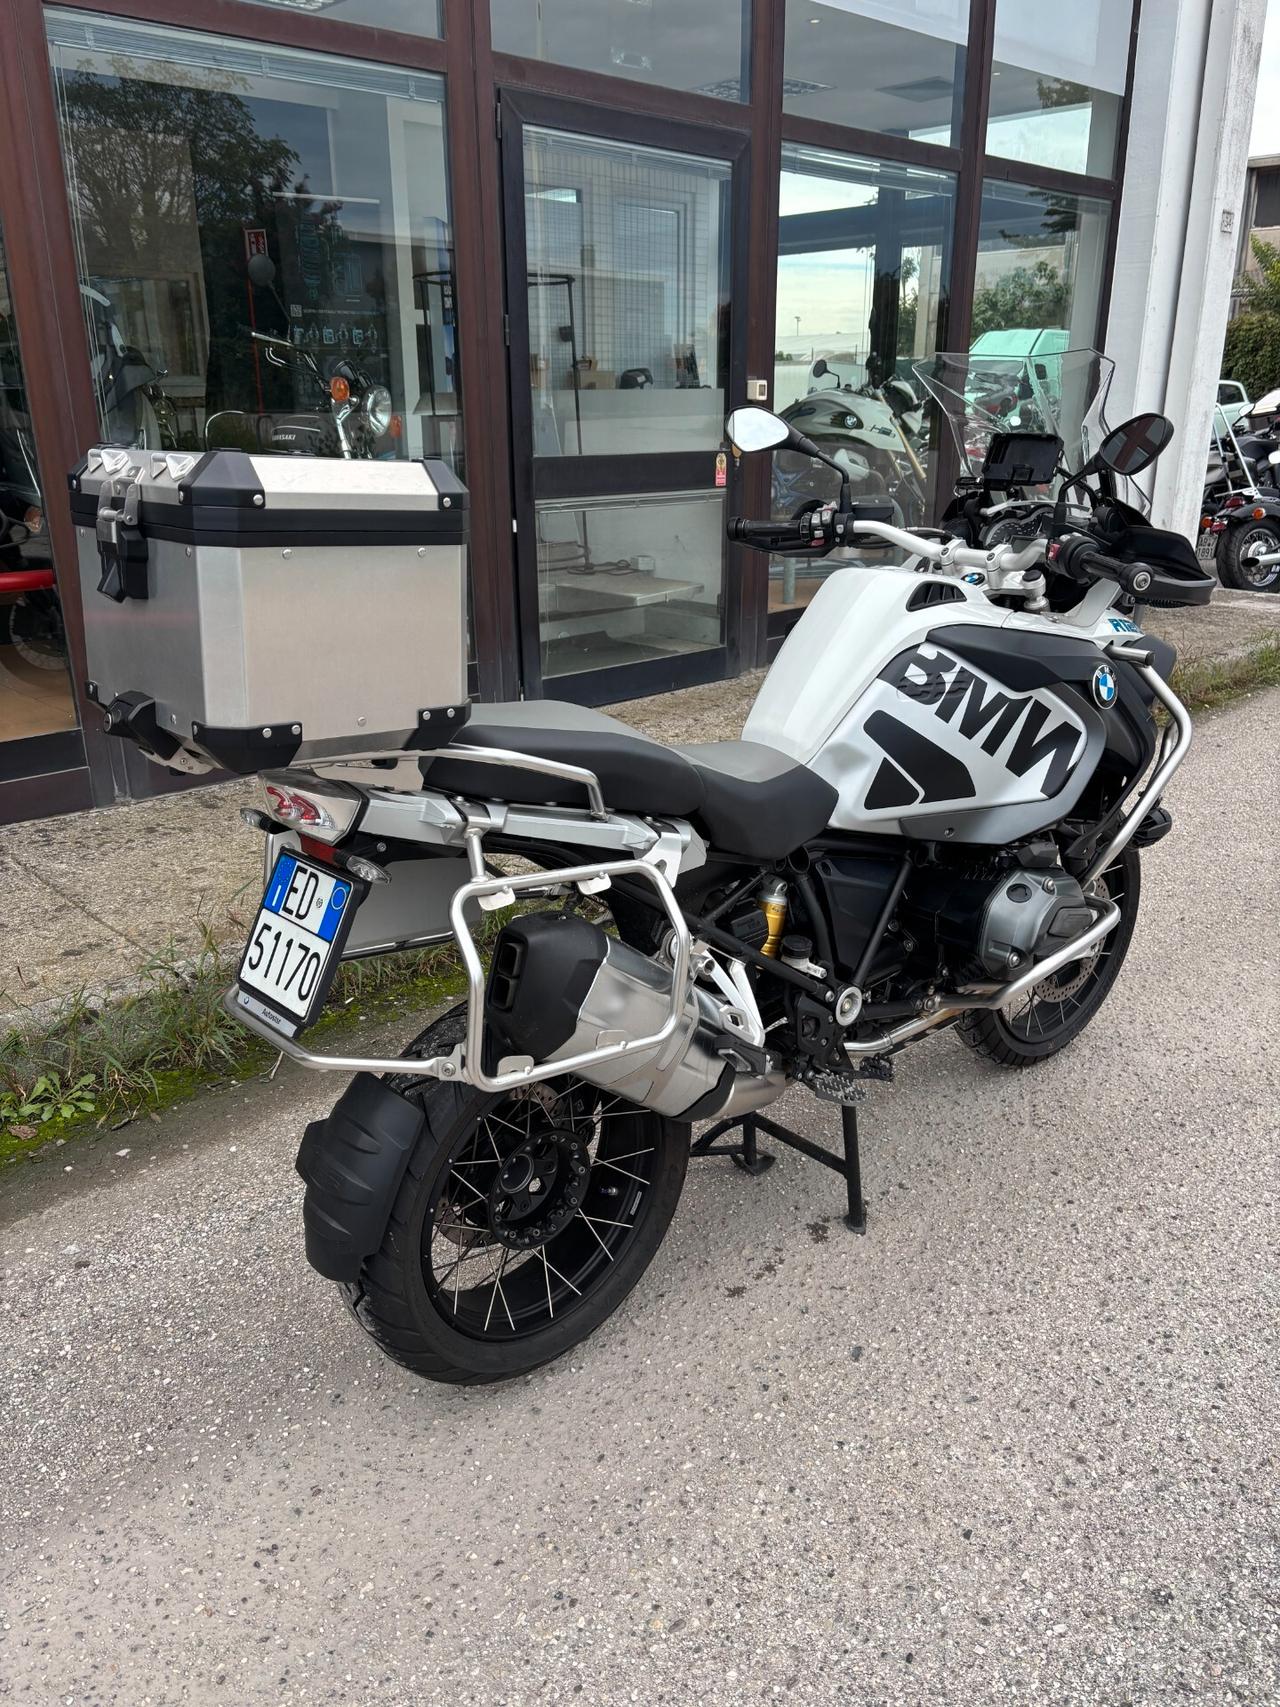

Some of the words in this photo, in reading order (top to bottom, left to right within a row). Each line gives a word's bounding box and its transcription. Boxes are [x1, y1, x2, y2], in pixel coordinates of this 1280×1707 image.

[877, 642, 1083, 800] BMW
[282, 865, 320, 920] ED
[248, 923, 321, 1001] 51170
